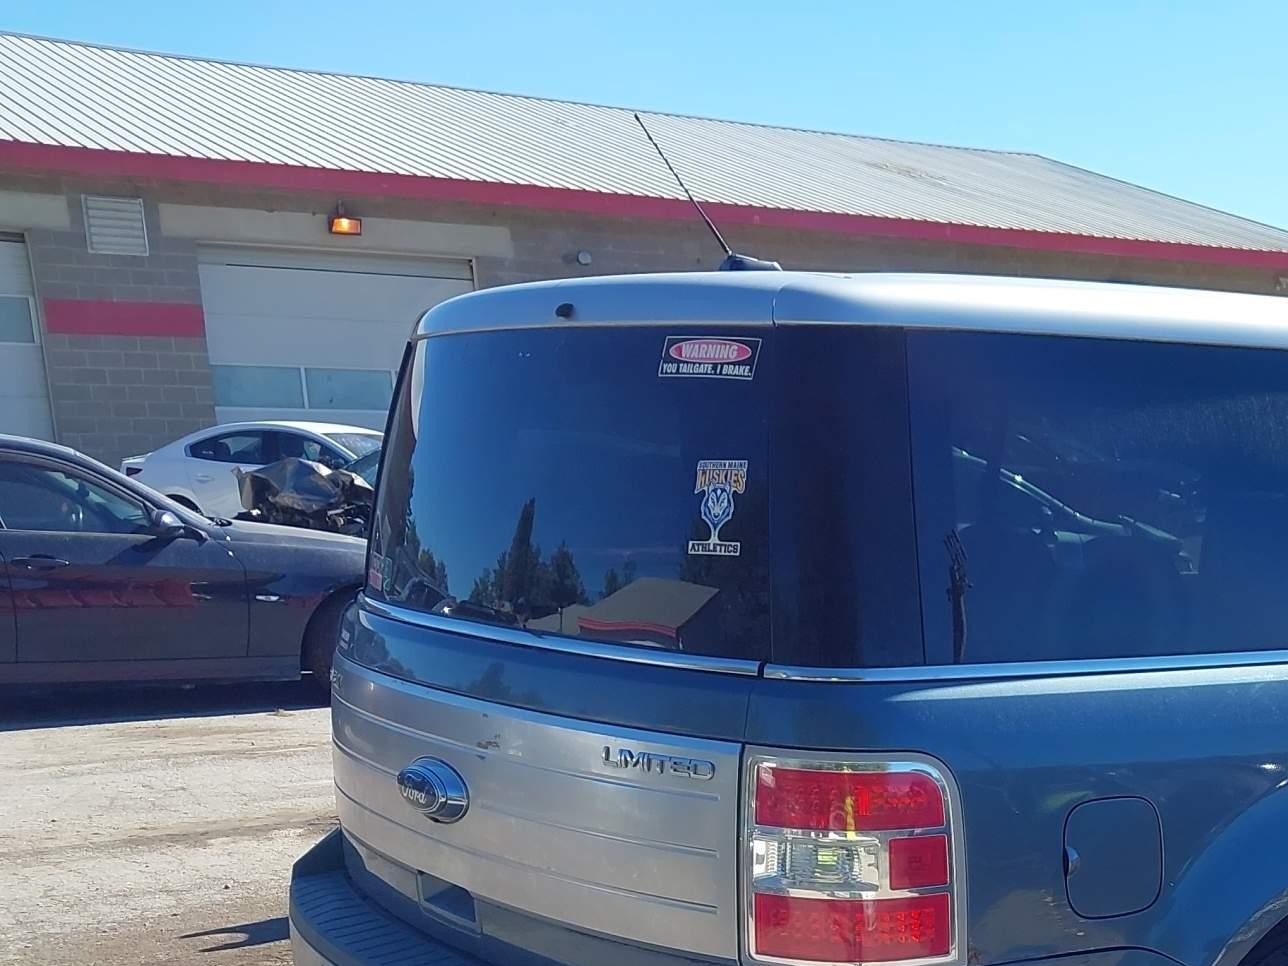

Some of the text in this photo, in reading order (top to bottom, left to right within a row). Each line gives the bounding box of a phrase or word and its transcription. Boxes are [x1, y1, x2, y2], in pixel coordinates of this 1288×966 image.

[681, 343, 738, 359] WARNING
[662, 363, 676, 374] YOU
[679, 363, 715, 375] TAILGATE.
[722, 365, 752, 376] BRAKE.
[695, 469, 746, 492] HUSKIES
[690, 543, 739, 554] ATHLETICS
[602, 745, 716, 781] LIMITED
